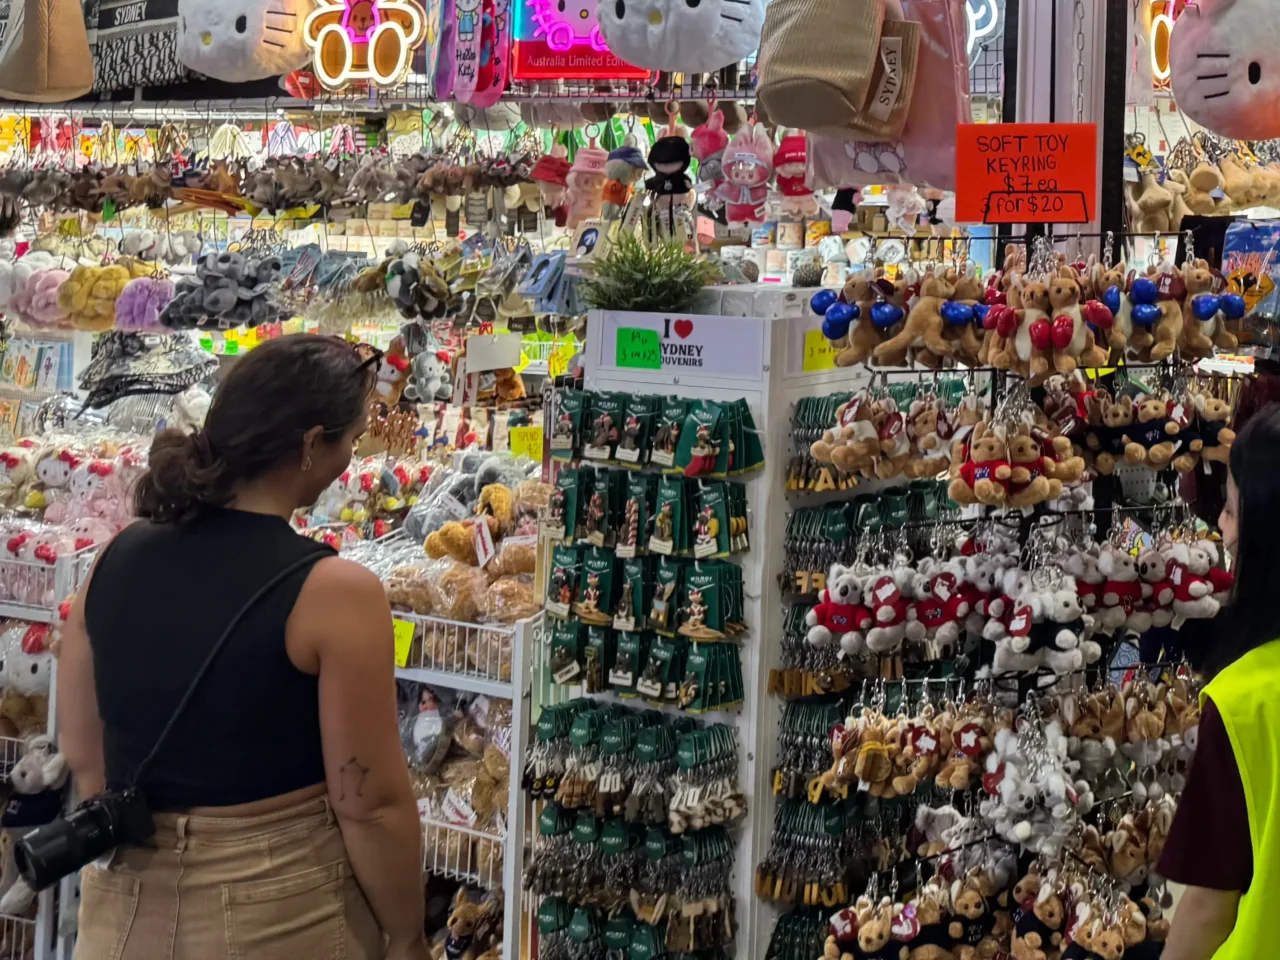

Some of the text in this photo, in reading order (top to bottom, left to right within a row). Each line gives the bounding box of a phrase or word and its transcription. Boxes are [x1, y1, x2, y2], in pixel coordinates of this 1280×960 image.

[114, 1, 148, 30] SYDNEY
[456, 47, 477, 62] Hello
[526, 53, 567, 68] Australia
[568, 53, 603, 68] Limited
[880, 46, 897, 106] SYDNEY
[976, 133, 1069, 153] SOFT TOY
[986, 155, 1057, 174] KEYRING
[980, 193, 1064, 216] 3 for $20
[663, 318, 671, 339] I
[660, 342, 704, 357] YDNEY
[660, 356, 703, 367] OUVENIRS
